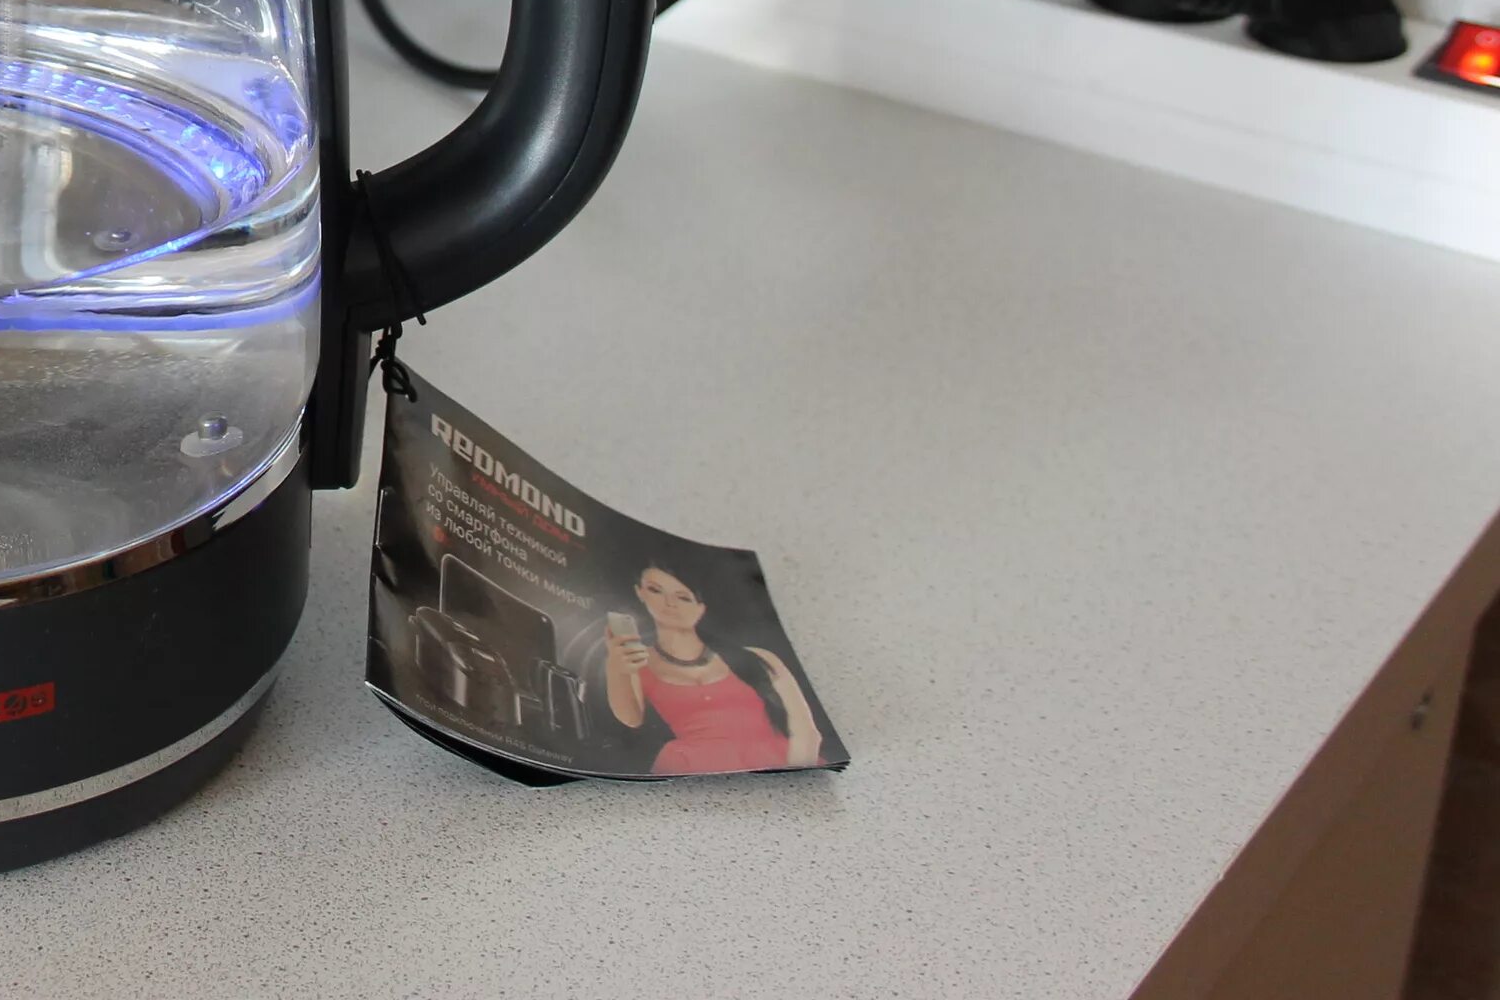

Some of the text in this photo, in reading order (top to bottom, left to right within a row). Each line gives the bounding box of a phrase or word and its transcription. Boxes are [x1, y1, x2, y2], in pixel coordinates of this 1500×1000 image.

[431, 413, 586, 537] REDMOND
[444, 518, 492, 557] любой
[496, 550, 540, 586] точки
[447, 500, 527, 561] смартфона
